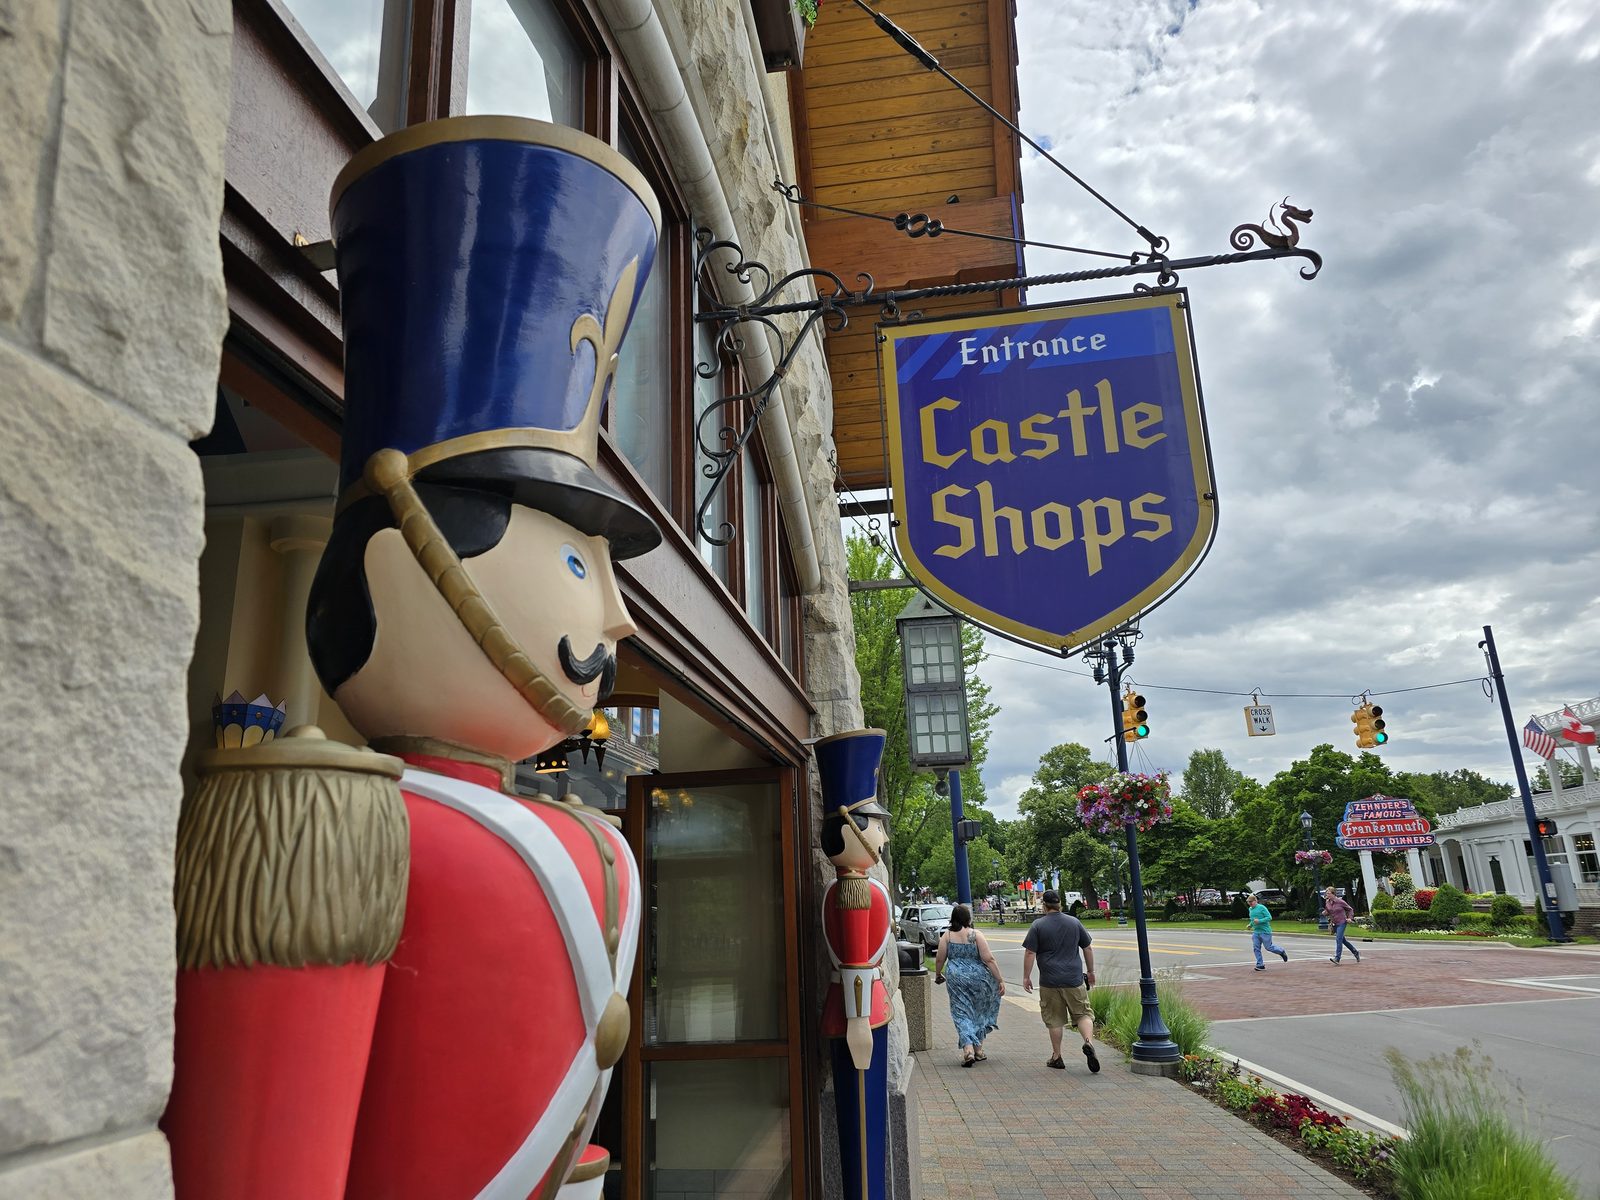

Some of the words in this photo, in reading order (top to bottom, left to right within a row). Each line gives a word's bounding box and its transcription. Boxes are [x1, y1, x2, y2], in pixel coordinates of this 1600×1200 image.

[958, 333, 1107, 365] Entrance
[919, 378, 1168, 470] Castle
[931, 480, 1173, 577] Shops
[1250, 708, 1271, 716] CROSS
[1353, 801, 1408, 811] ZEHNDER'S
[1363, 810, 1402, 819] FAMOUS
[1344, 820, 1425, 837] Frankenmuth
[1343, 838, 1386, 847] CHICKEN
[1389, 835, 1432, 845] DINNERS
